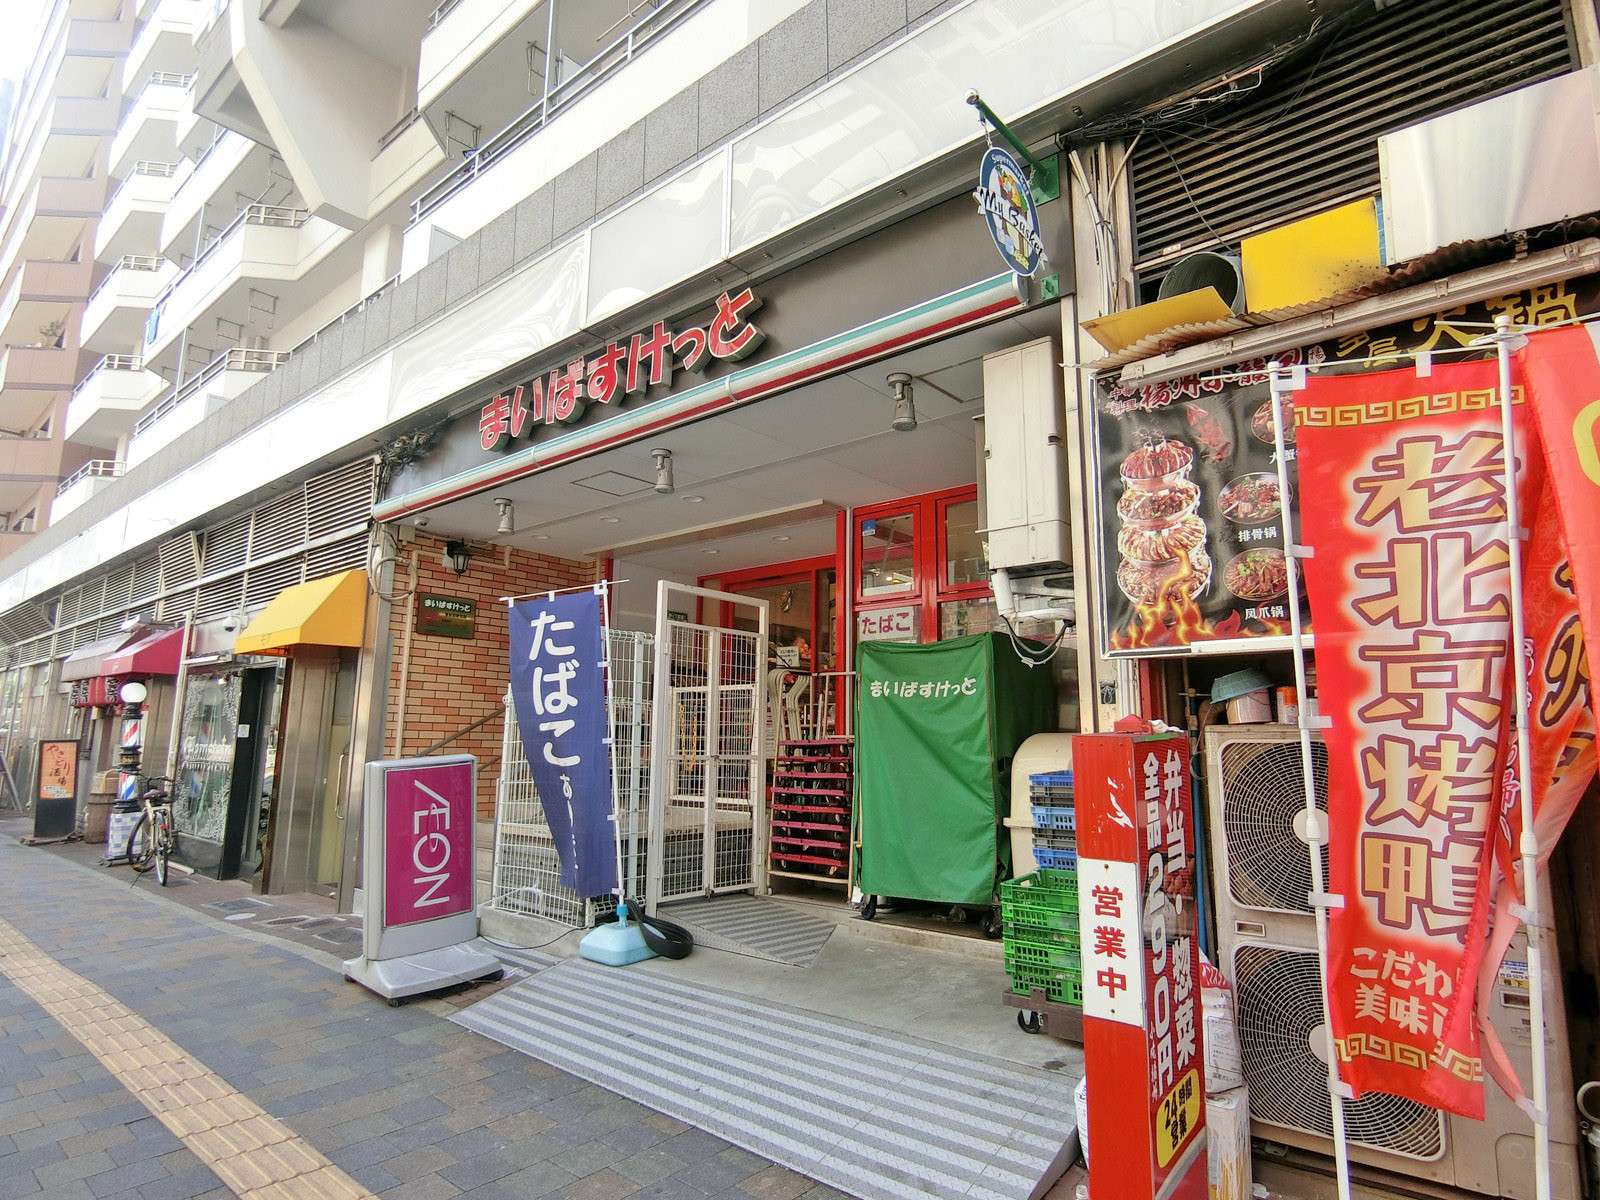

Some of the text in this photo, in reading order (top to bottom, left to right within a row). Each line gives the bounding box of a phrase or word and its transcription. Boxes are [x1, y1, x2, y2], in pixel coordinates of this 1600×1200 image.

[991, 153, 1030, 196] Supermarket
[980, 186, 1044, 257] My Basket
[479, 287, 757, 451] まいばすけっと
[1238, 526, 1277, 543] 排骨锅
[424, 599, 470, 612] まいばすけっと
[862, 612, 911, 635] たばこ
[1245, 605, 1284, 621] 凤爪锅
[528, 611, 581, 767] たばこ
[870, 677, 977, 699] まいばすけっと
[1351, 430, 1521, 945] 老北京烤鴨
[413, 779, 451, 908] AEON
[1091, 885, 1128, 999] 営業中
[1143, 752, 1175, 1097] 全品290円
[1163, 749, 1197, 1072] 弁当・惣菜
